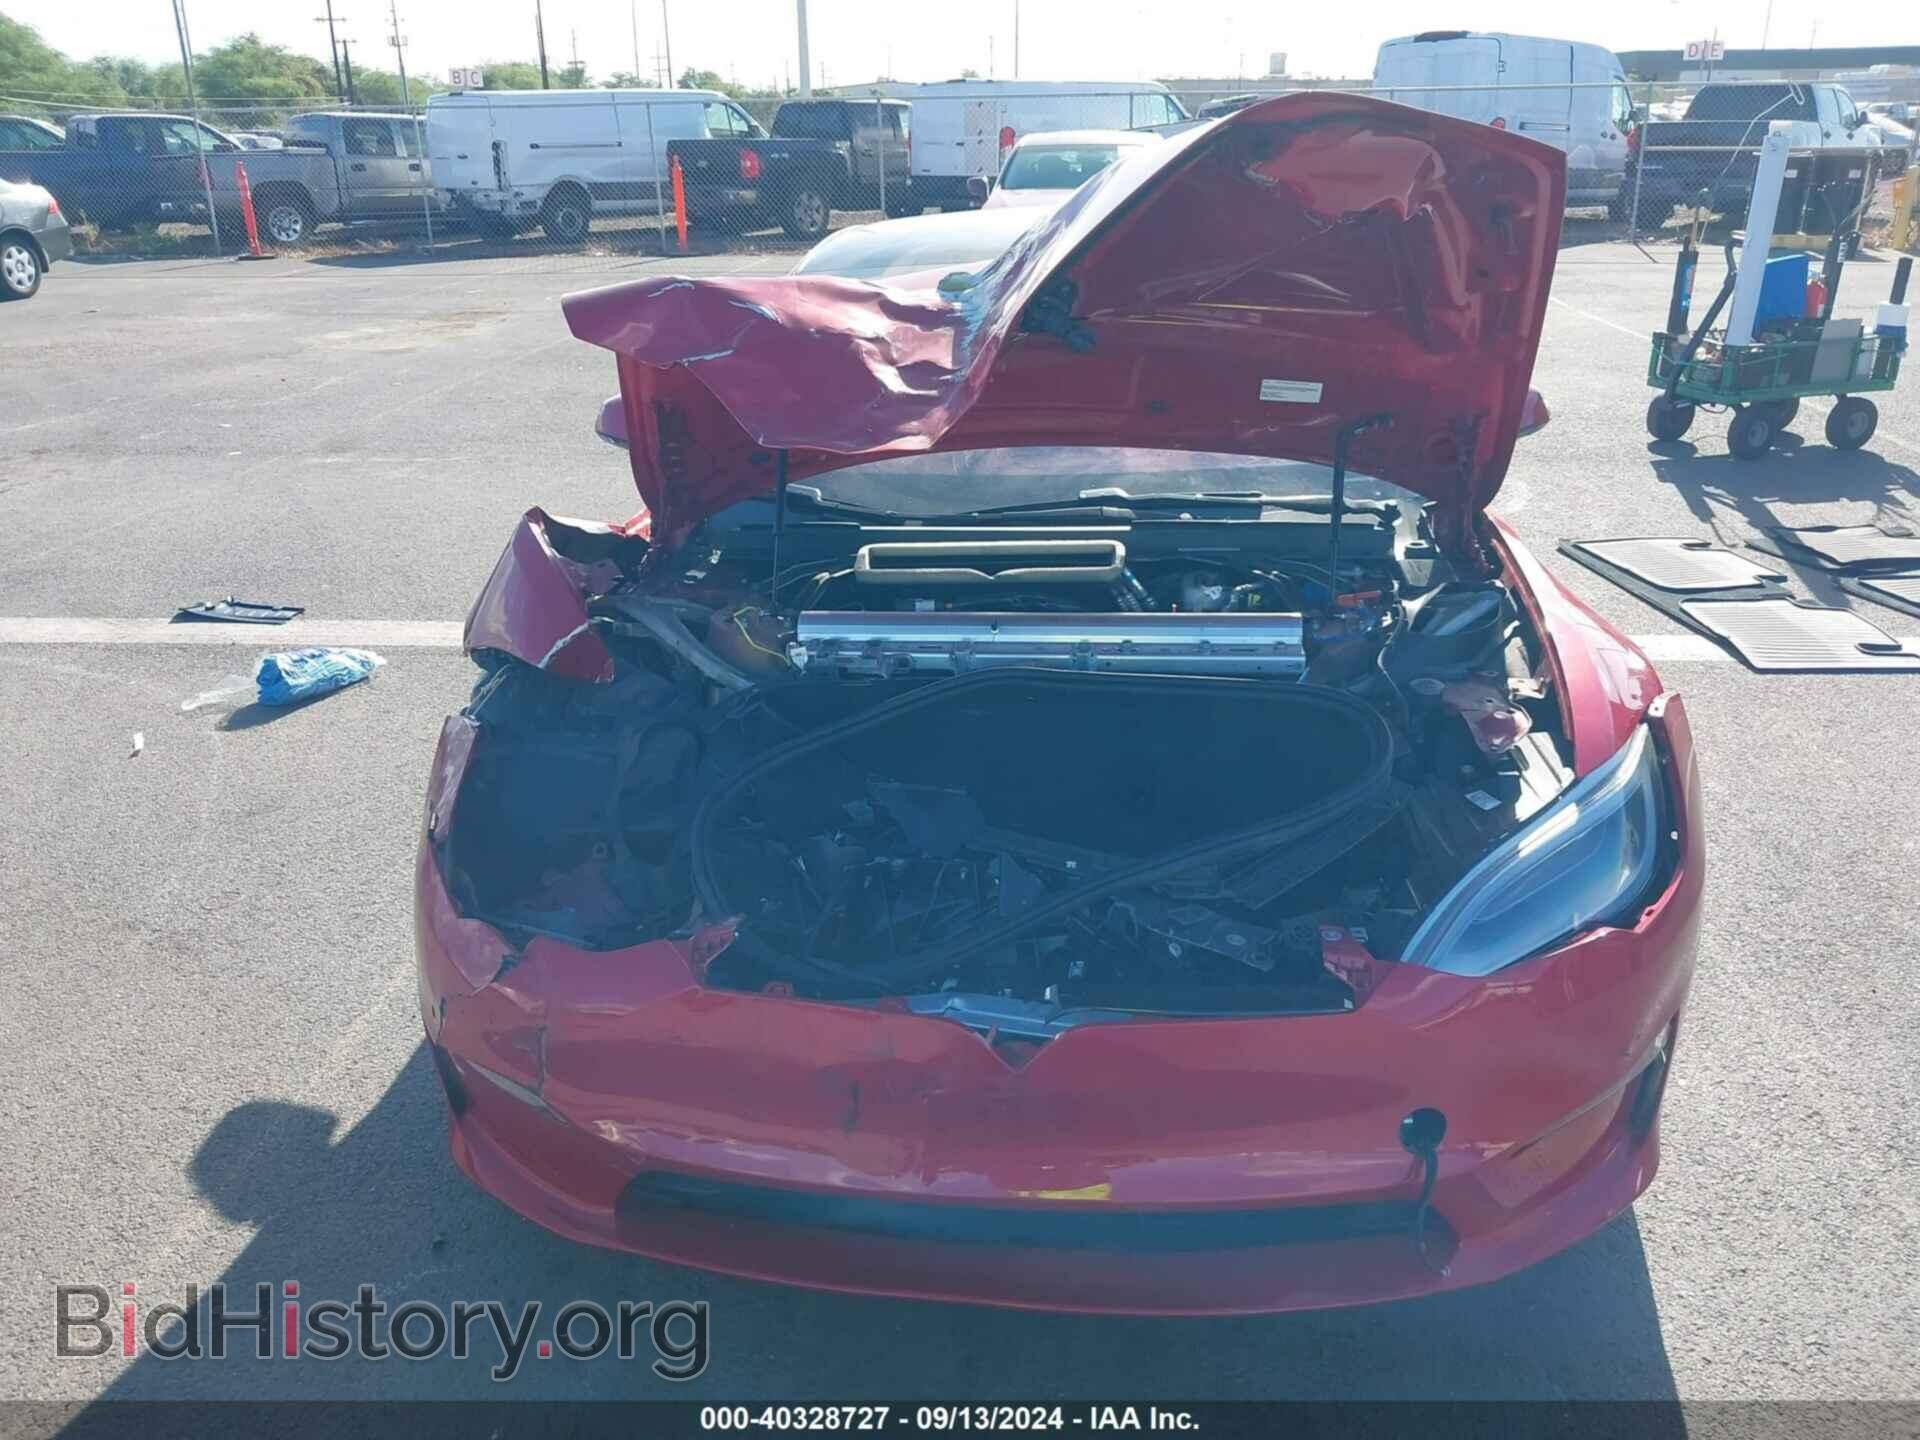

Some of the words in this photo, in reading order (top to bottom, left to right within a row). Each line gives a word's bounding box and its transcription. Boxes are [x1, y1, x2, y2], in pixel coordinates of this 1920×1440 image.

[1688, 43, 1698, 58] D
[1711, 43, 1721, 58] E
[452, 71, 462, 85] B
[471, 71, 480, 85] C
